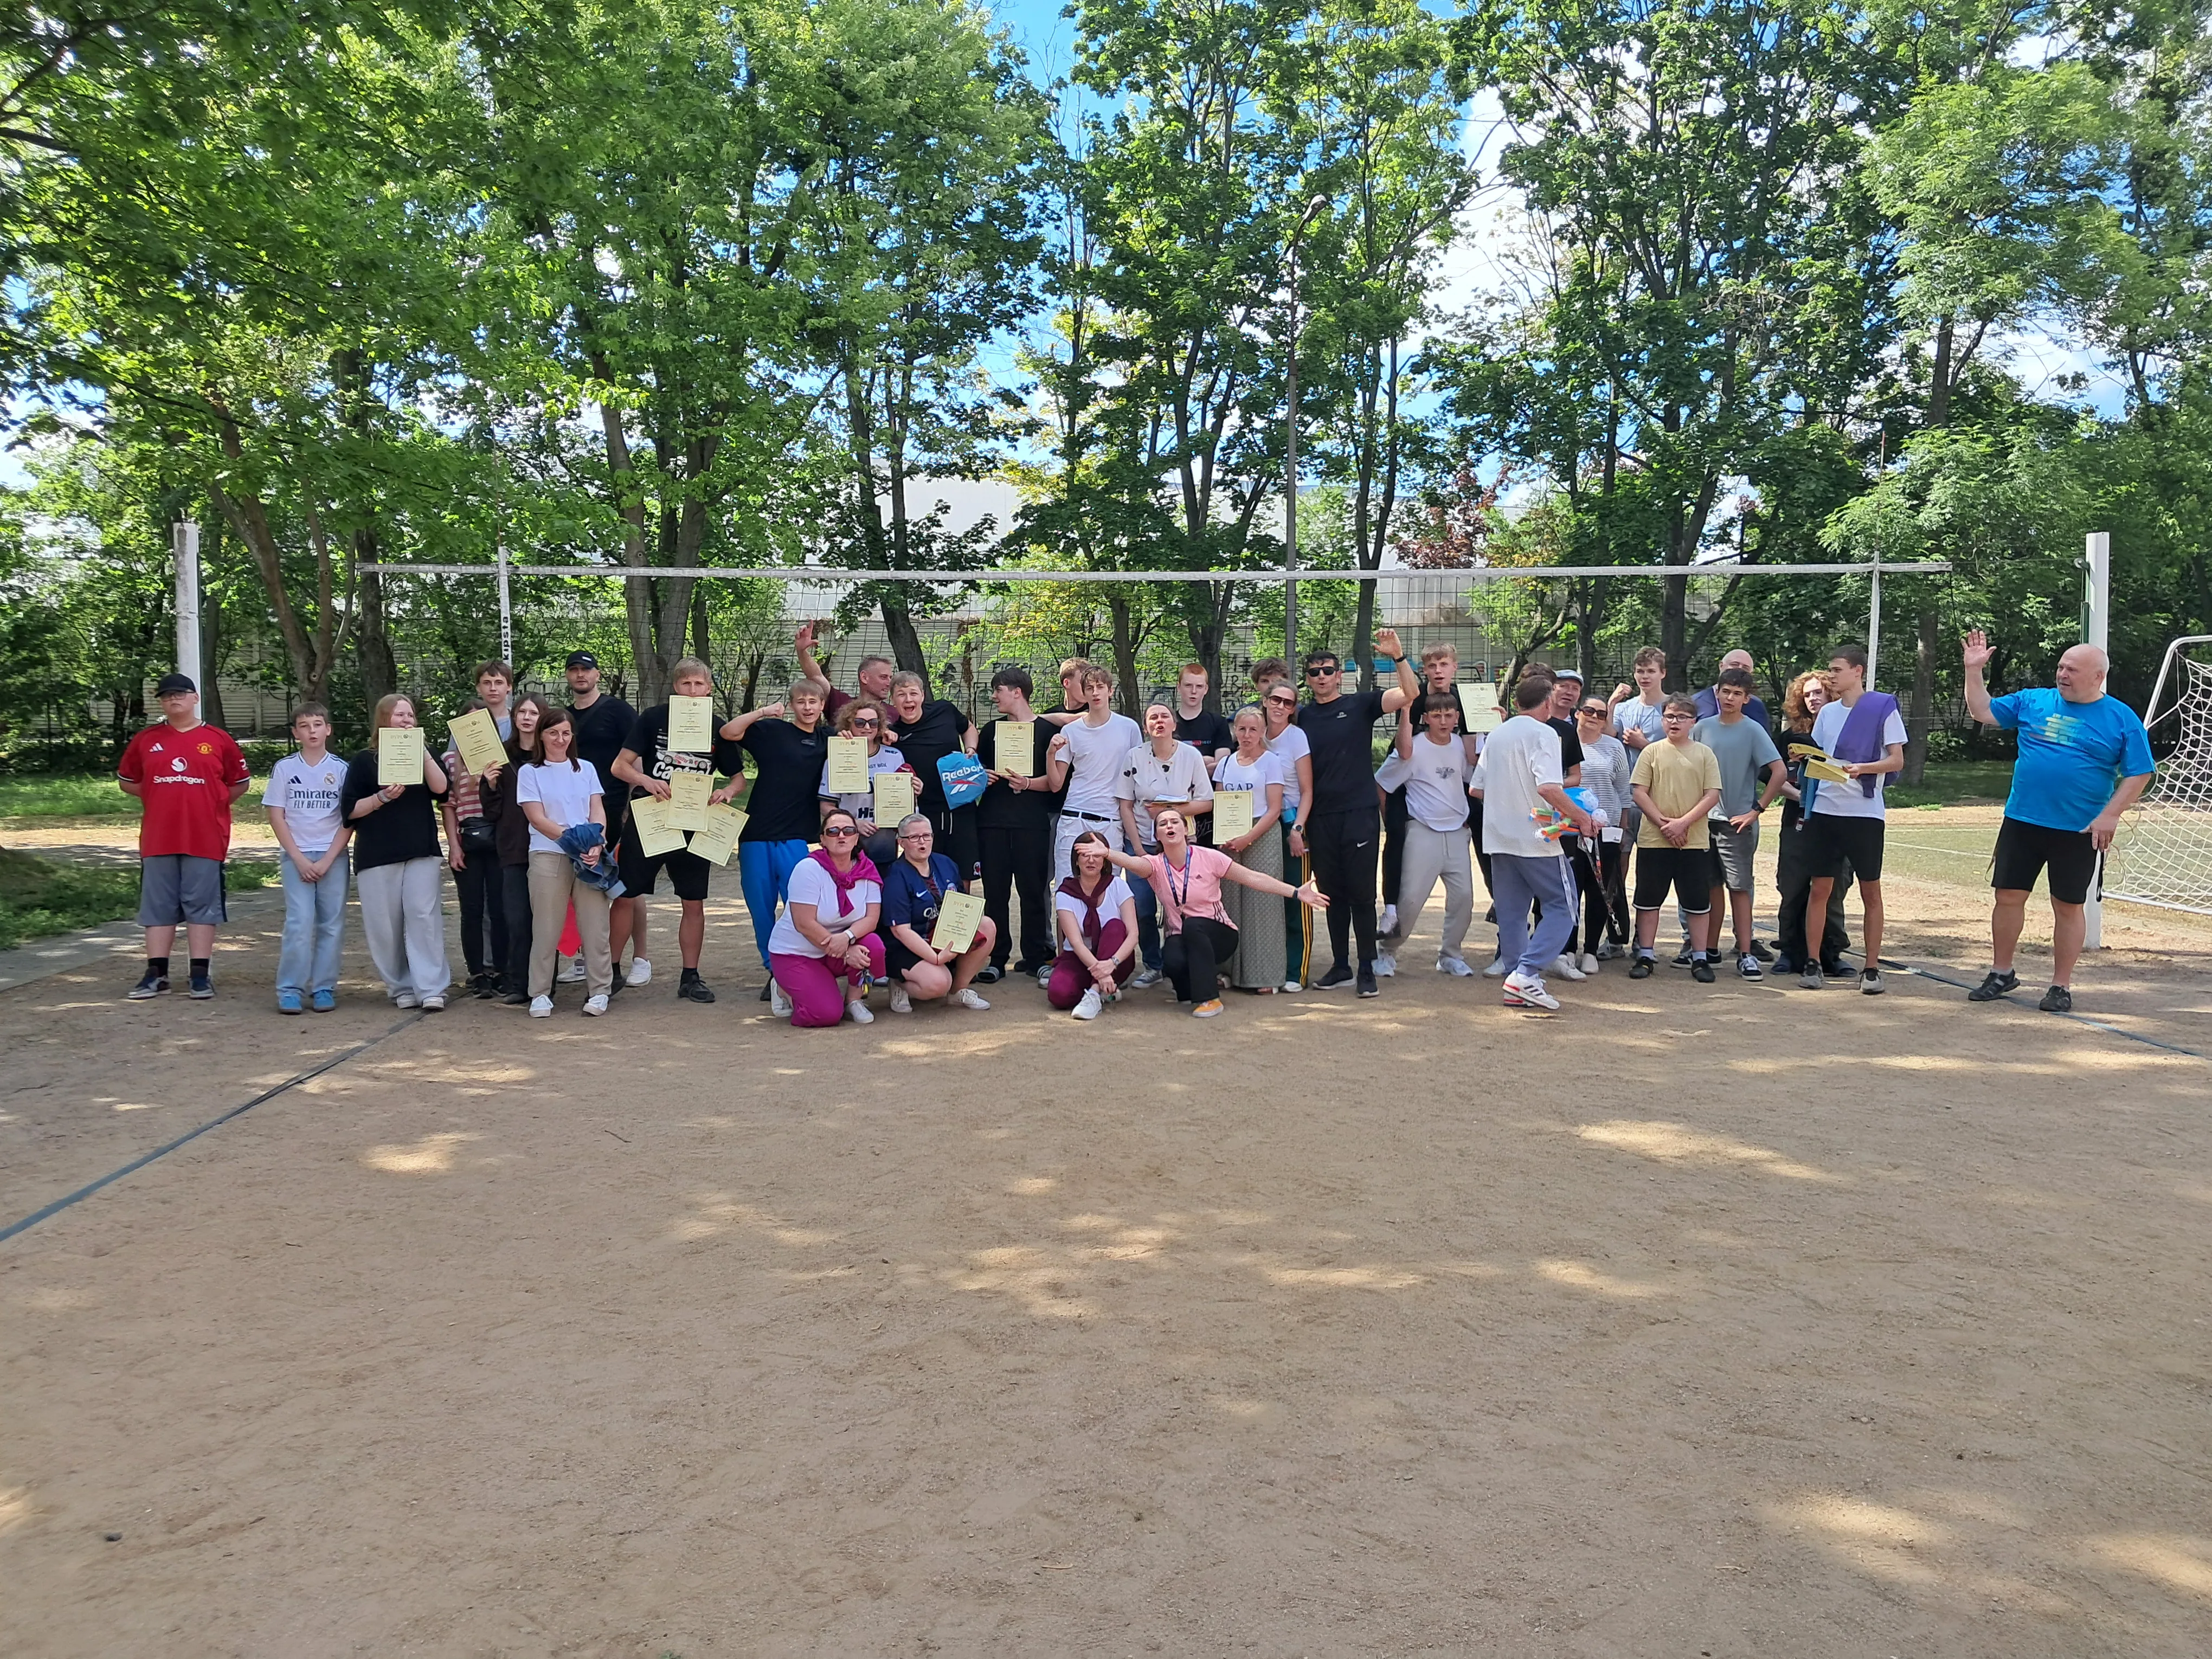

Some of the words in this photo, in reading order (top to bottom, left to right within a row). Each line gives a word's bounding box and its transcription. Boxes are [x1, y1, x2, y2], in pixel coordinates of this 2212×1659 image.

[942, 763, 984, 782] Reebok
[153, 775, 205, 785] Snapdragon
[1225, 783, 1253, 792] GAP
[294, 800, 304, 808] FLY
[306, 800, 331, 808] BETTER
